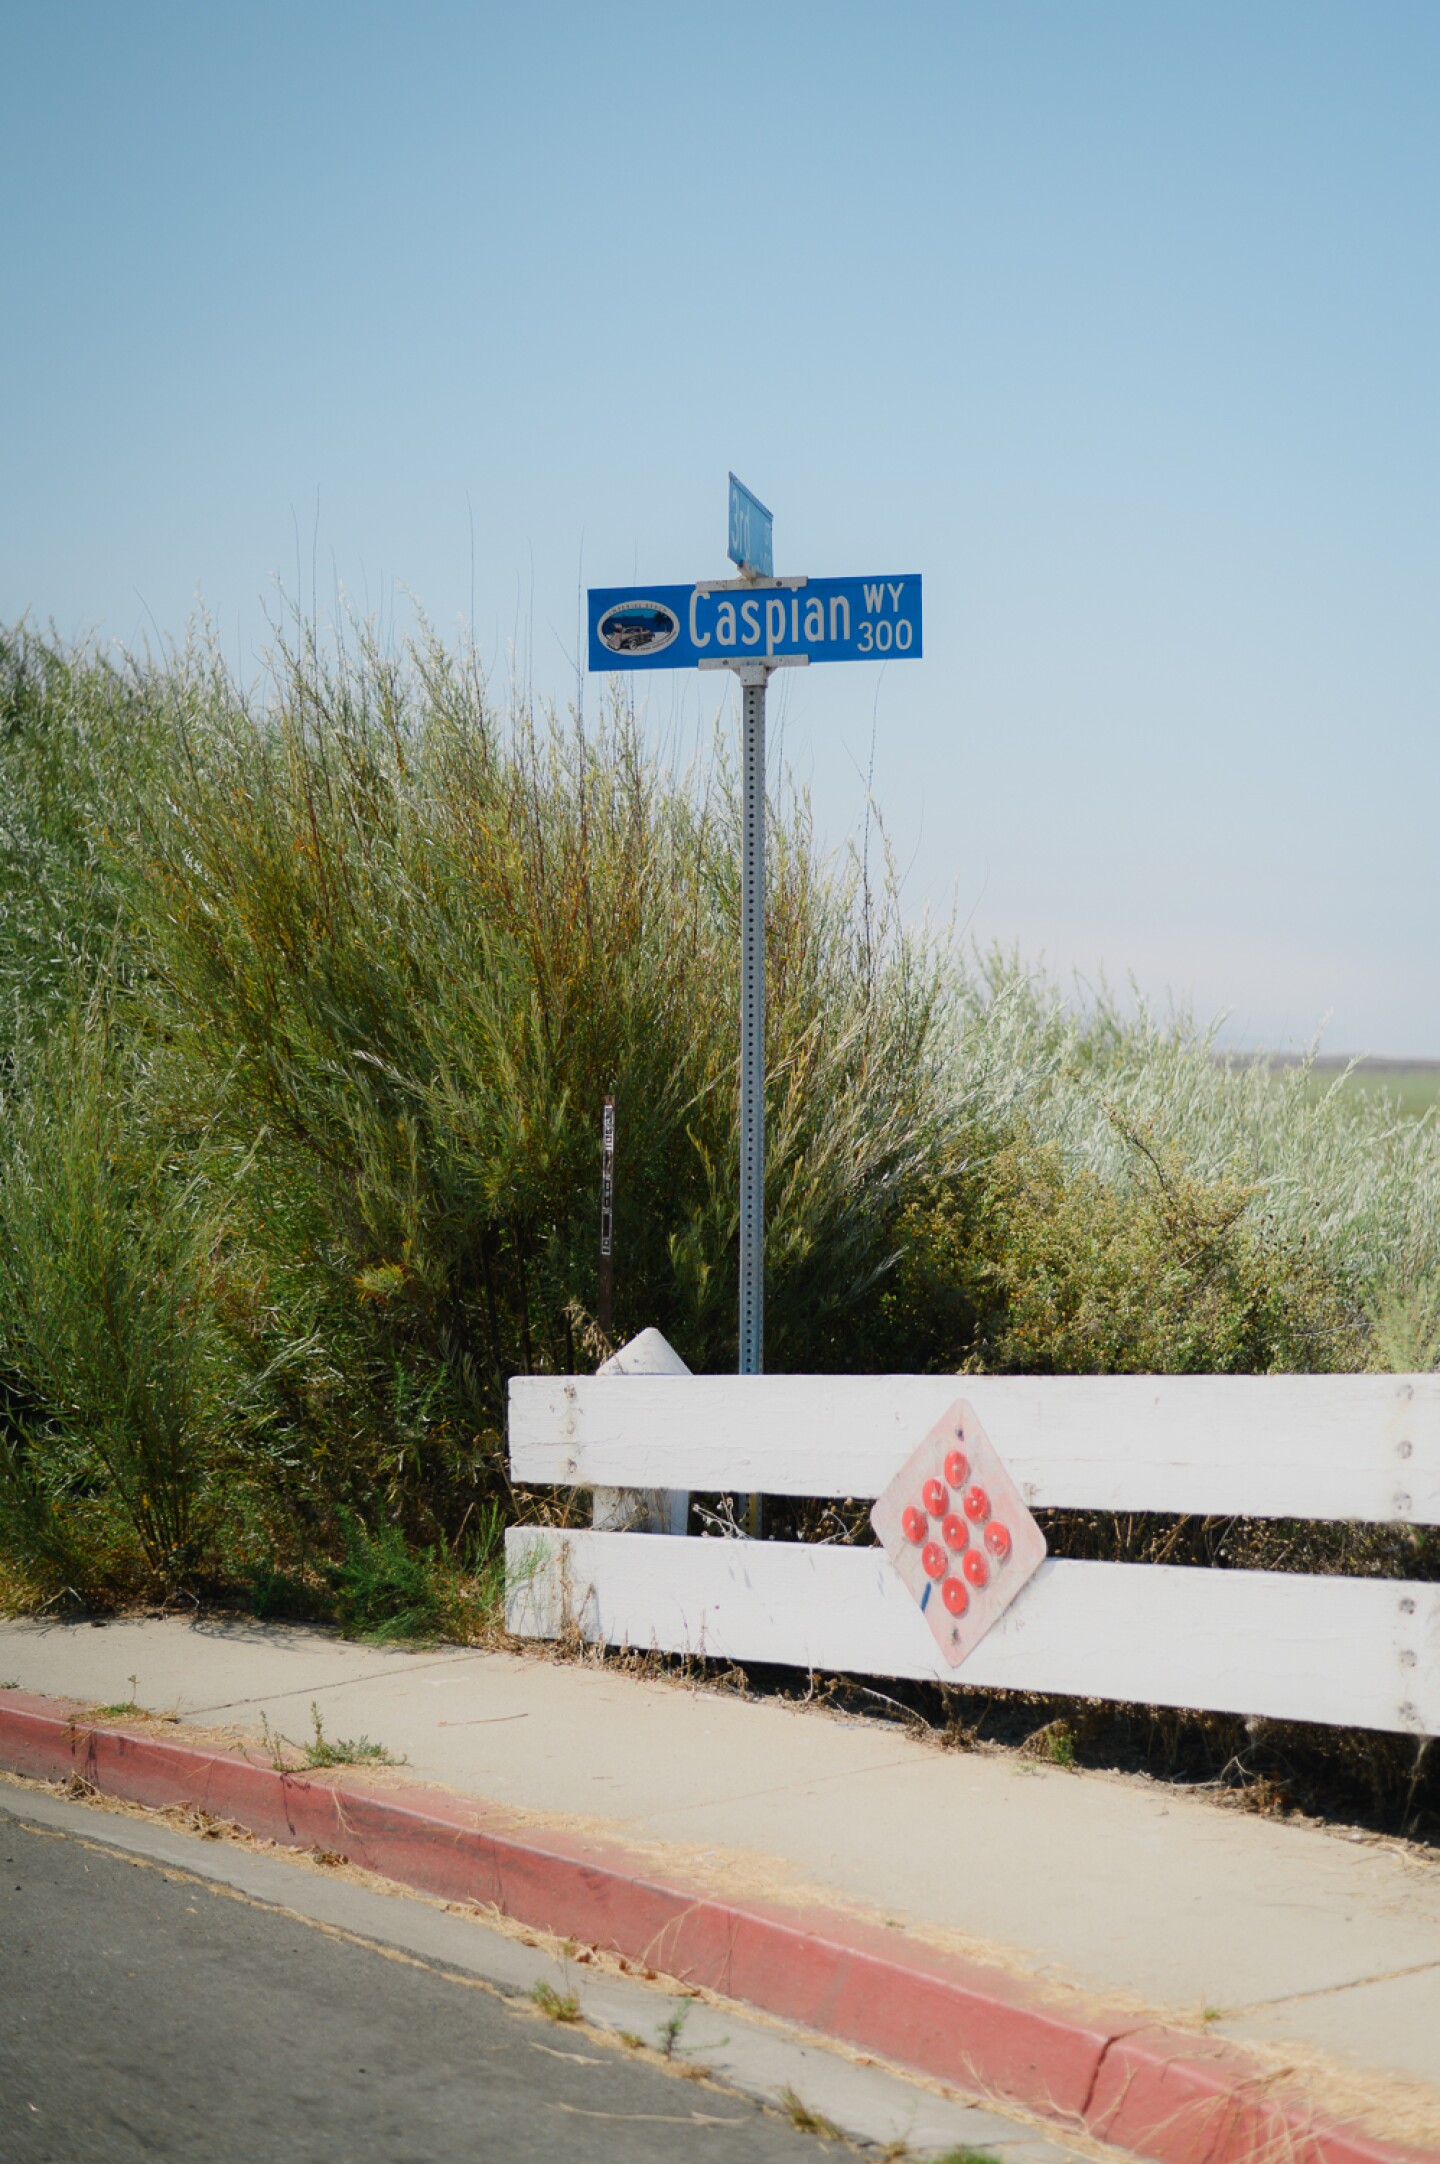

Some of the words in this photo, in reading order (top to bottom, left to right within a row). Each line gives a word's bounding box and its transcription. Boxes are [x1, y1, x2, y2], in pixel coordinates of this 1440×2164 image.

[731, 490, 750, 561] 3rd
[689, 587, 851, 656] Caspian
[863, 582, 905, 614] WY
[857, 618, 913, 652] 300
